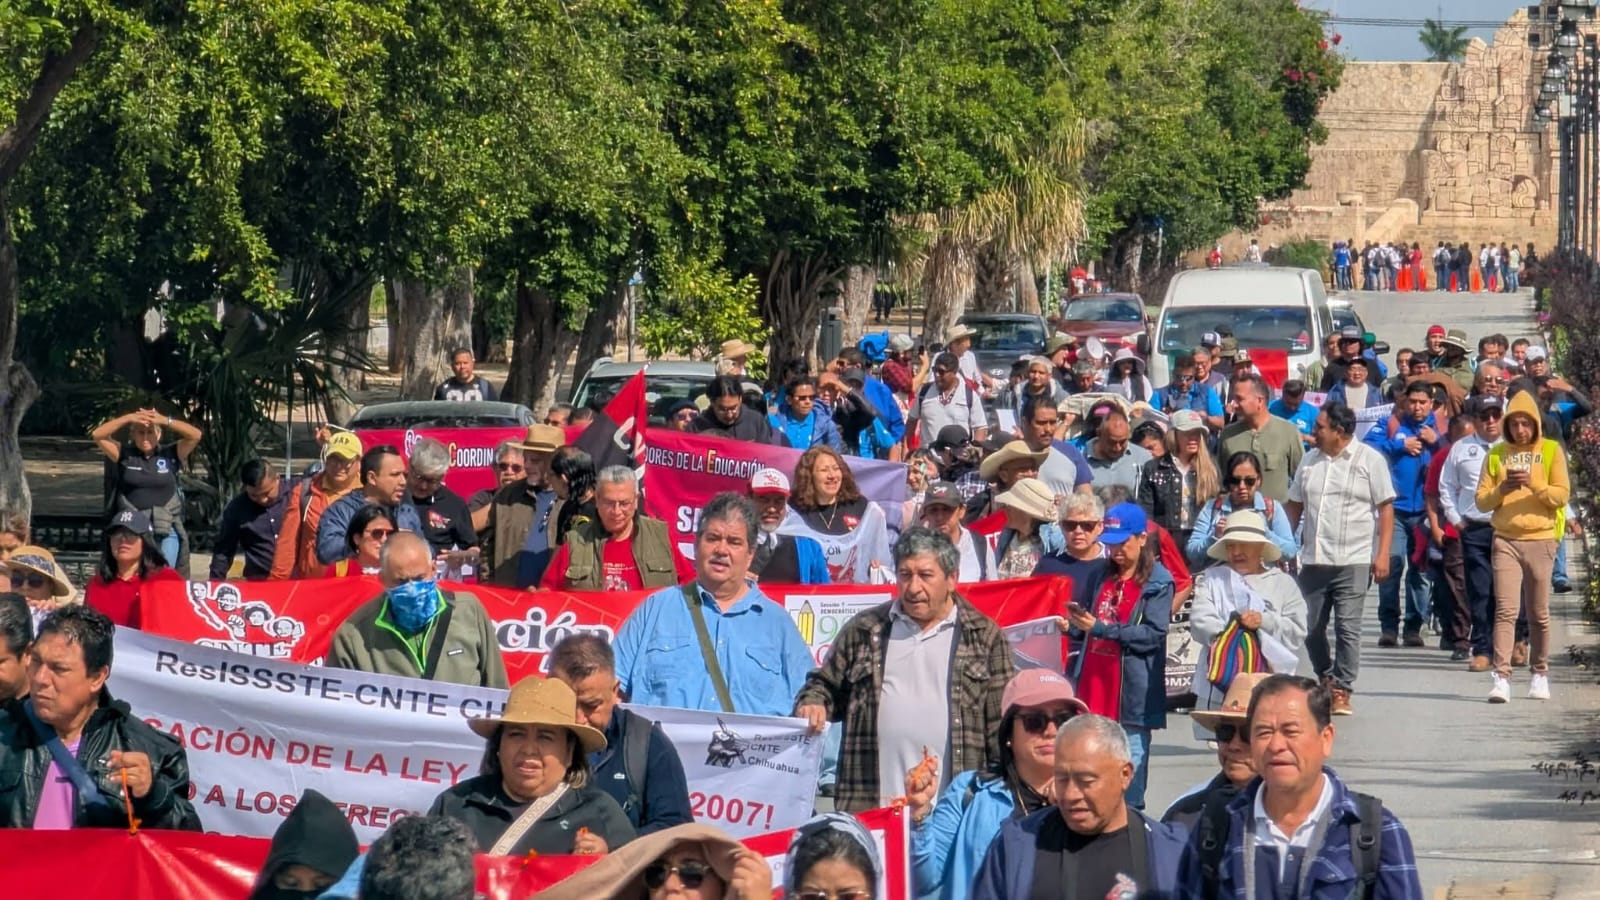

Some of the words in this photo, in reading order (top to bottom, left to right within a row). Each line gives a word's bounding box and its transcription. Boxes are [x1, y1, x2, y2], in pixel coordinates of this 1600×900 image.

[677, 452, 690, 469] DE
[692, 455, 704, 472] LA
[156, 651, 449, 716] ResISSSTE-CNTE
[286, 741, 334, 769] DE
[344, 750, 388, 776] LA
[400, 757, 468, 786] LEY
[748, 756, 800, 775] Chihuahua
[203, 785, 226, 808] A
[235, 788, 297, 817] LOS
[689, 791, 774, 830] 2007!
